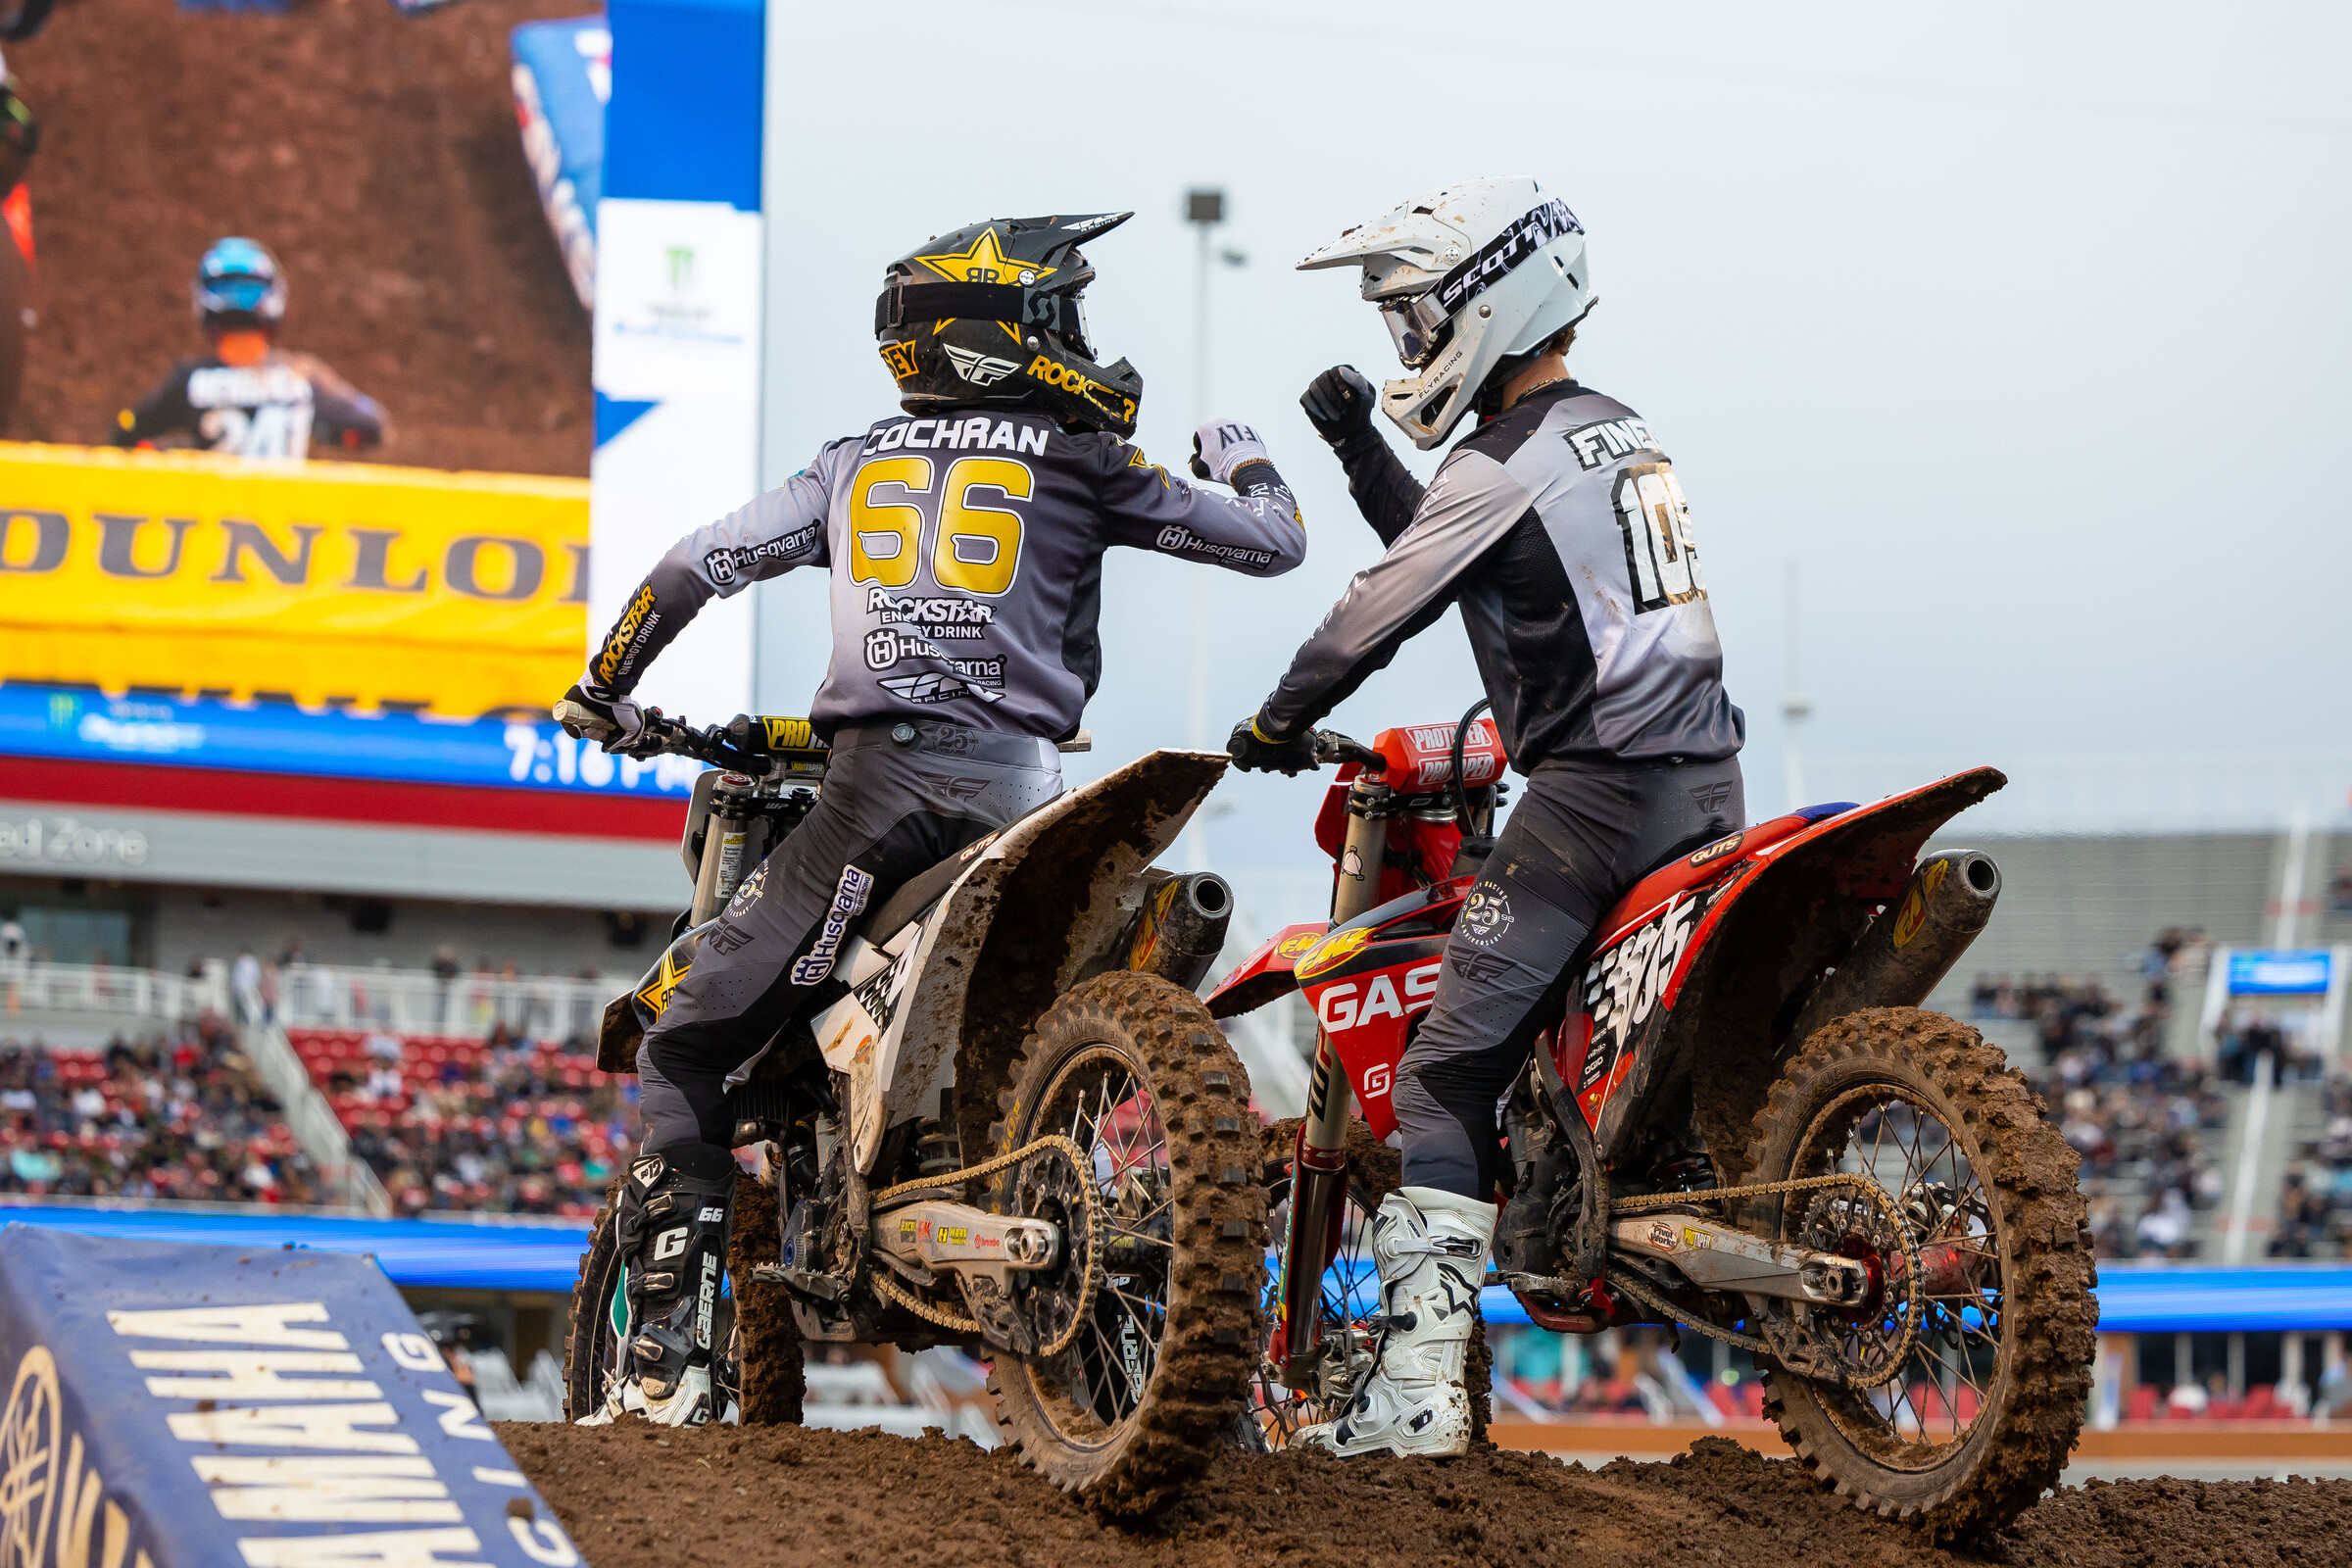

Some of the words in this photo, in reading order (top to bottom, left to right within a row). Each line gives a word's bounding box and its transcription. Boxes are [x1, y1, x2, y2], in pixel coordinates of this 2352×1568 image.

[1443, 221, 1540, 304] SCOTT
[862, 416, 1050, 457] COCHRAN
[849, 456, 1035, 596] 66
[734, 526, 815, 567] Husqvarna
[1183, 536, 1272, 564] Husqvarna
[599, 585, 657, 685] ROCKSTAR
[617, 642, 643, 676] ENERGY
[635, 610, 662, 644] DRINK
[934, 626, 982, 638] DRINK
[911, 690, 971, 704] RACIN
[939, 727, 969, 750] 25
[959, 832, 1000, 861] GUTS
[1690, 836, 1741, 863] GUTS
[814, 868, 860, 958] Husqvarna
[1465, 893, 1503, 926] 25
[1501, 913, 1515, 923] 98
[1318, 962, 1443, 1034] GAS
[1584, 1055, 1604, 1075] OGIO
[698, 1206, 724, 1223] 66
[1651, 1233, 1676, 1248] Works
[1653, 1226, 1673, 1239] Pivot
